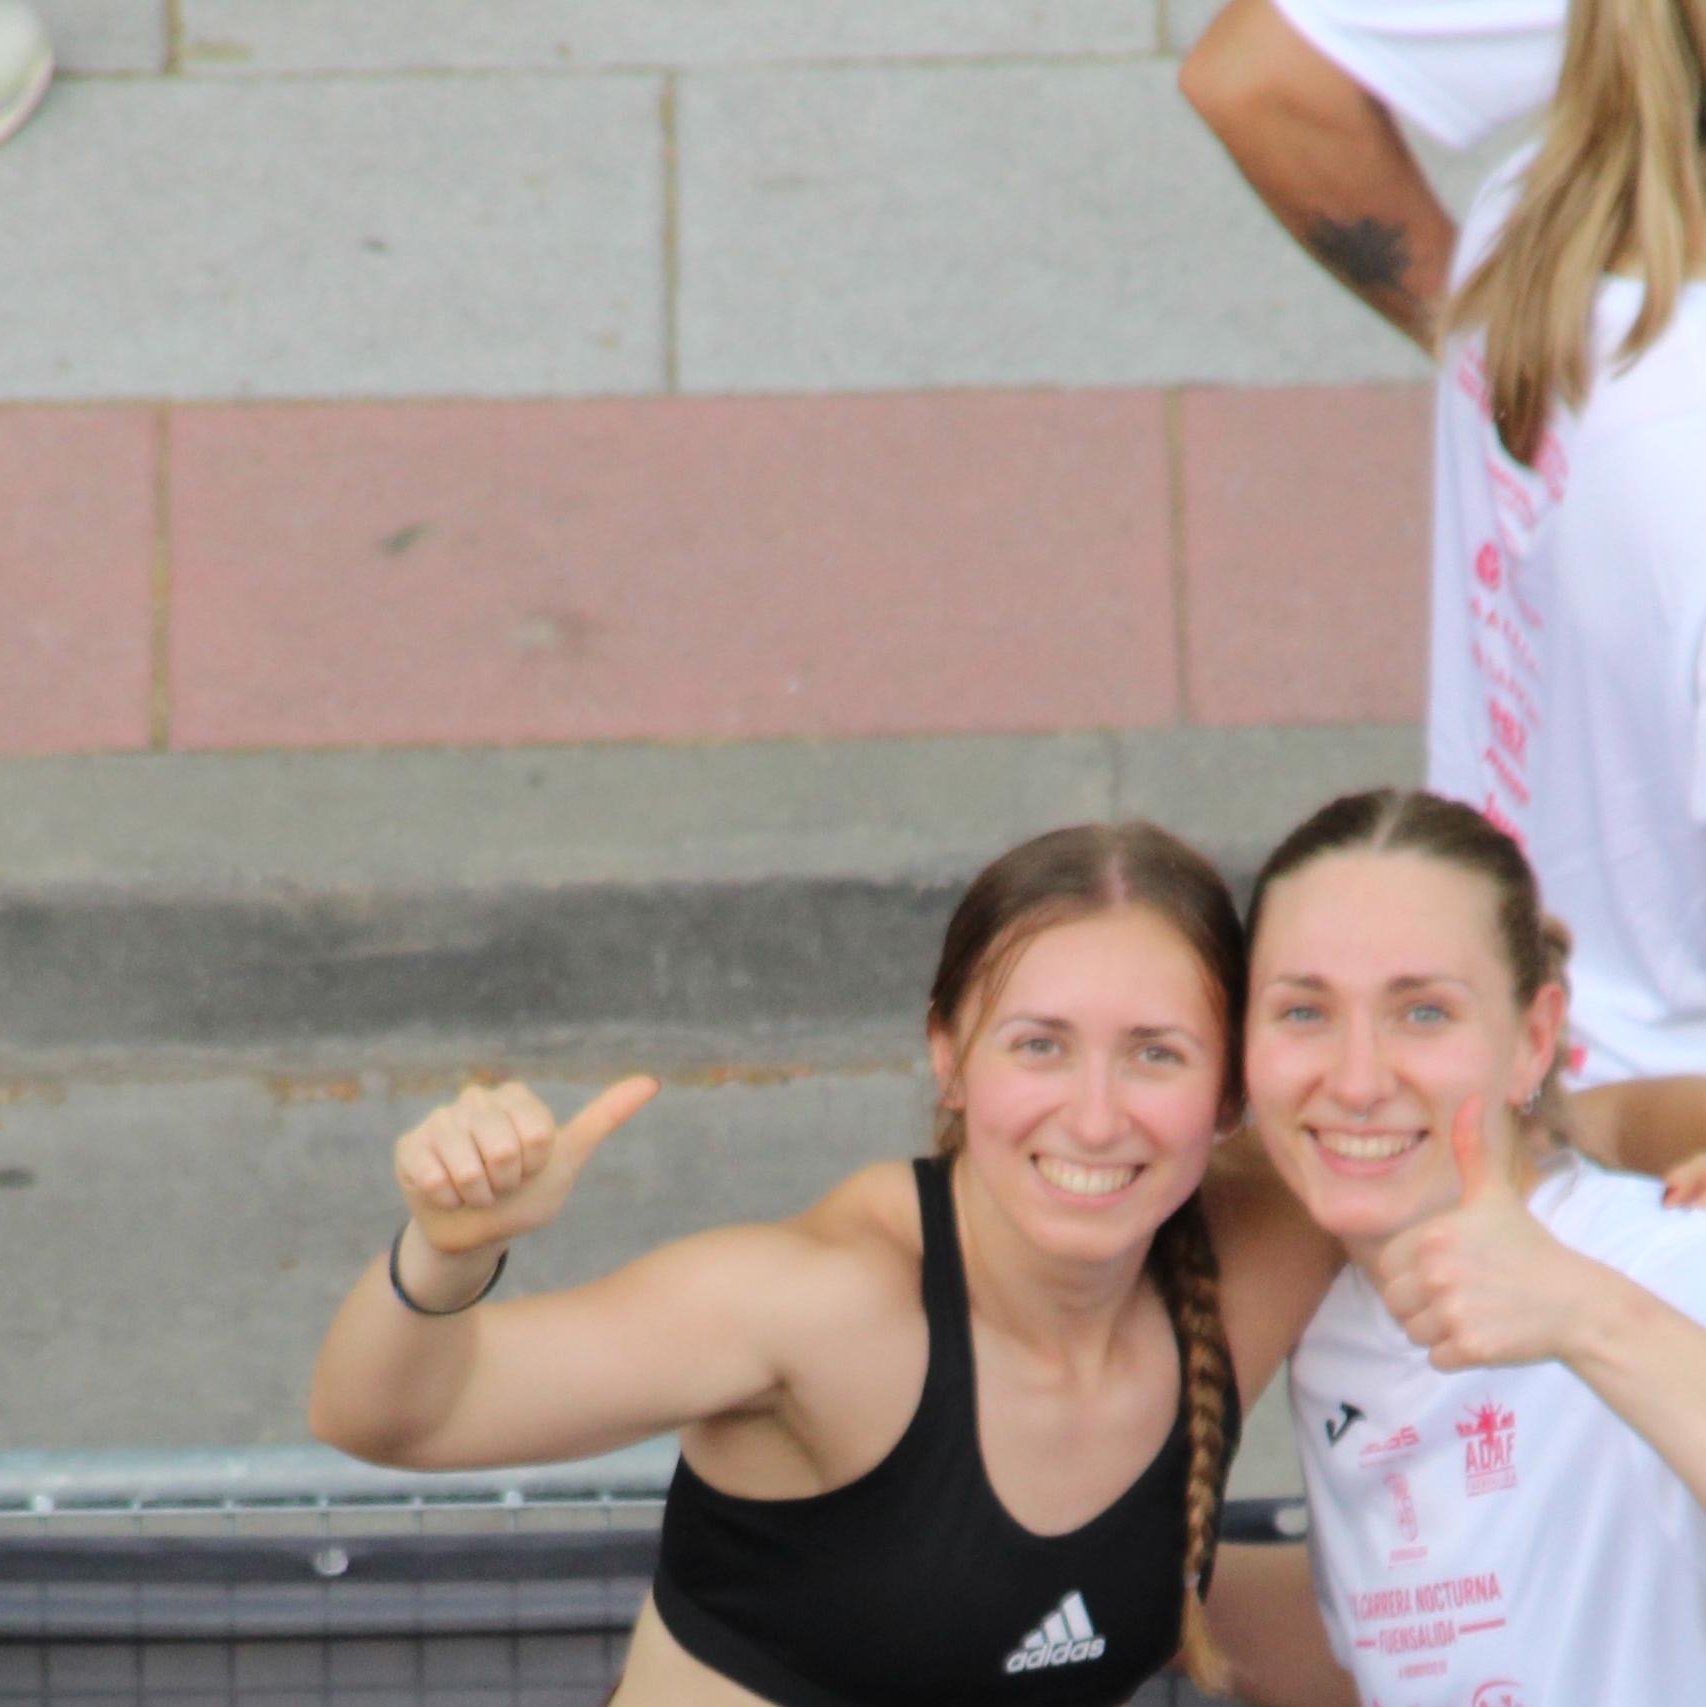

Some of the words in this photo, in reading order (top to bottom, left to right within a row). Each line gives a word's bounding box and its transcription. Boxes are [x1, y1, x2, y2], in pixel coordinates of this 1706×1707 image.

[1415, 1572, 1502, 1614] NOCTURNA
[1005, 1634, 1106, 1674] adidas
[1379, 1620, 1457, 1655] FUENSALIDA
